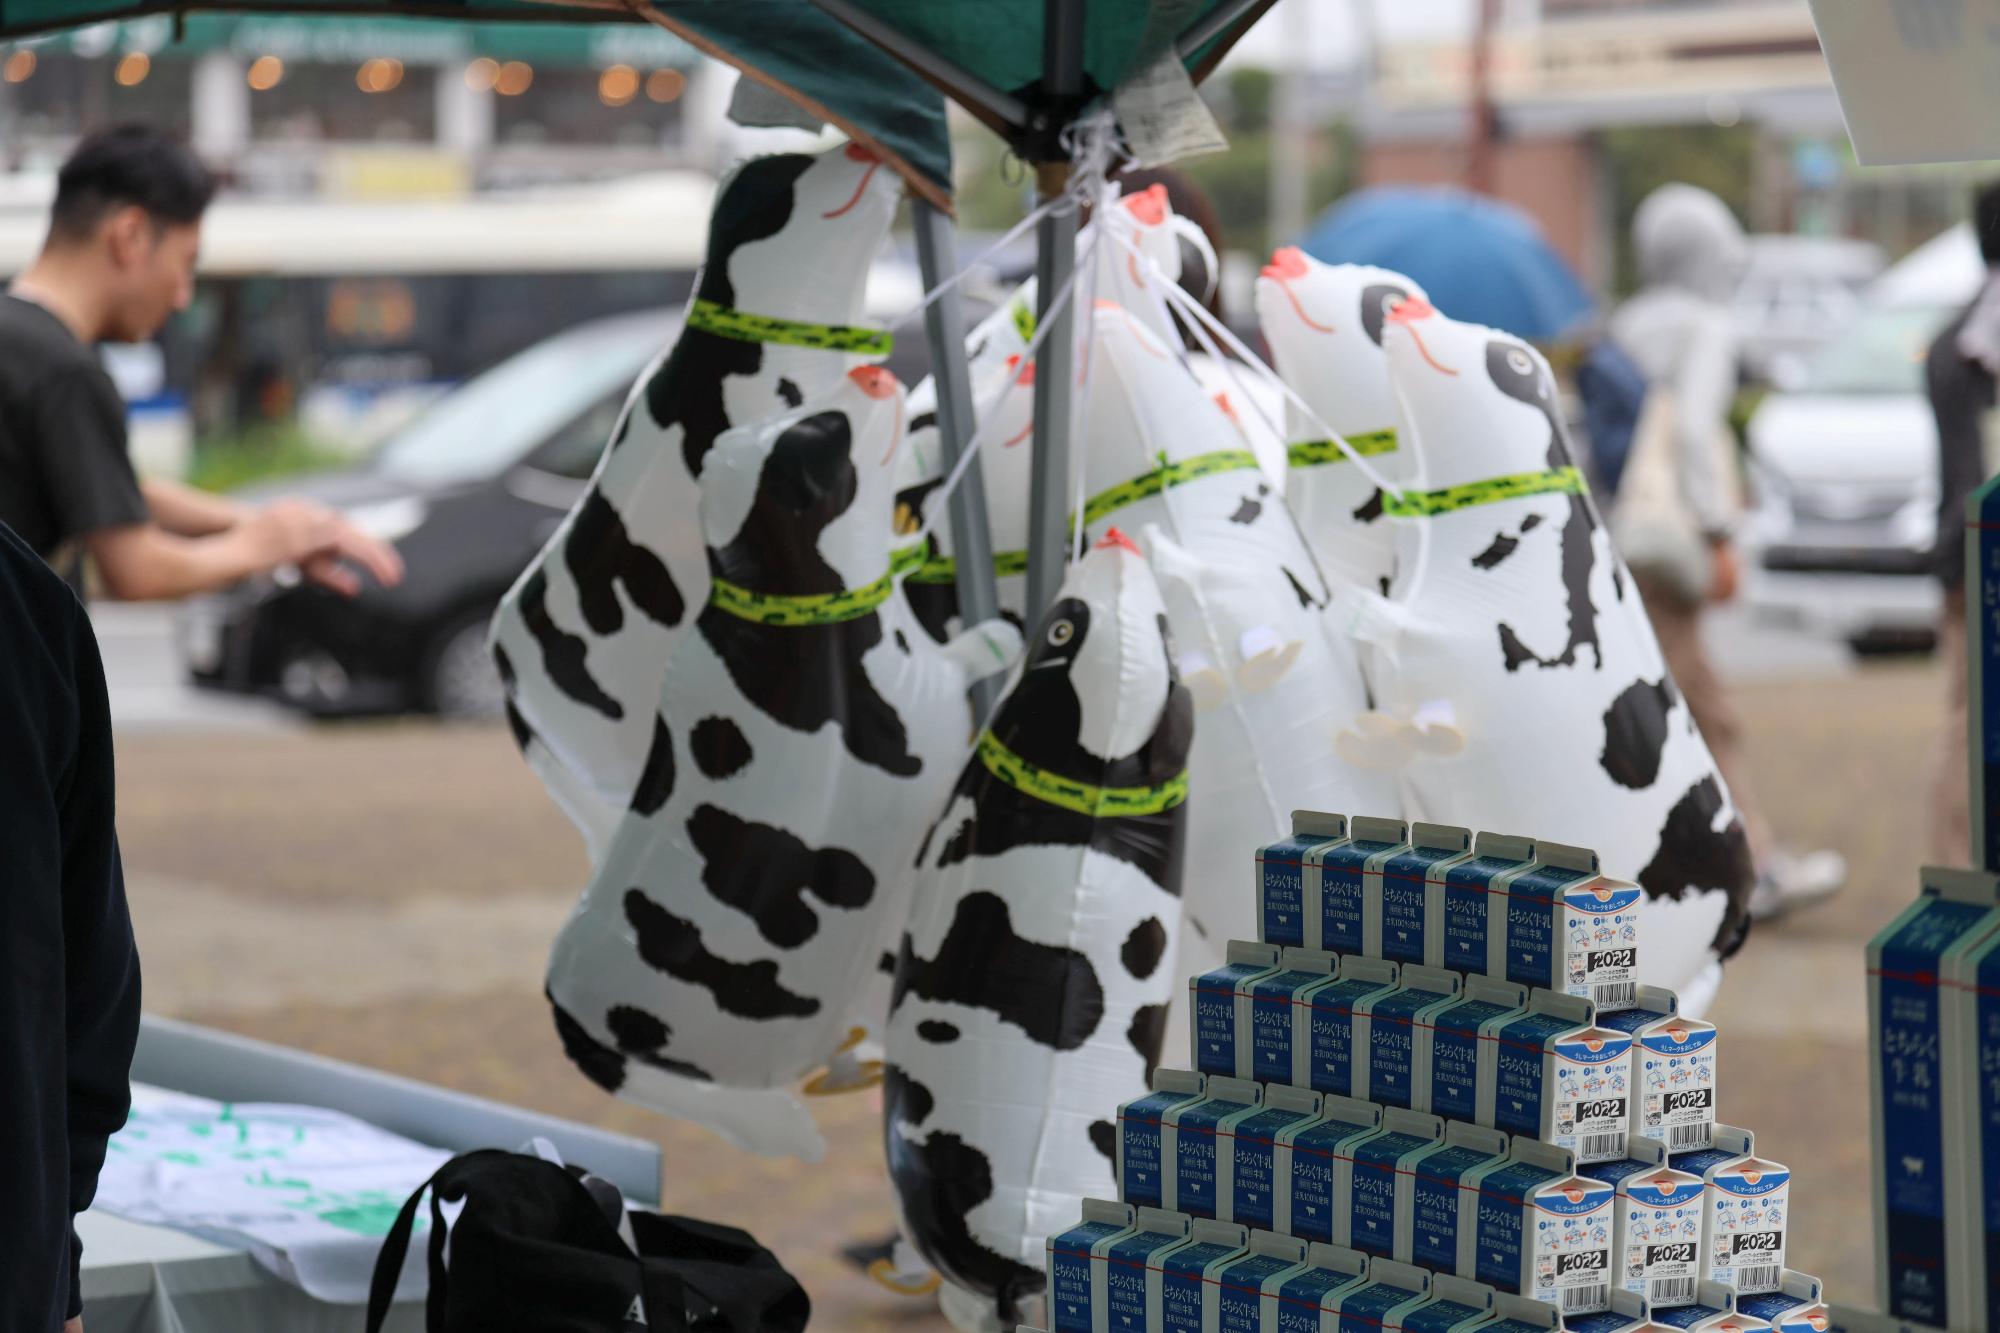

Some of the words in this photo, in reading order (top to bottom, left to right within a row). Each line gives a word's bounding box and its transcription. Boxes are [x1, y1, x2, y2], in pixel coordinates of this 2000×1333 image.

[1265, 873, 1302, 889] とちらく牛乳
[1323, 880, 1361, 897] とちらく牛乳
[1384, 888, 1423, 906] とちらく牛乳
[1446, 898, 1486, 916] とちらく牛乳
[1509, 909, 1551, 928] とちらく牛乳
[1594, 950, 1631, 968] 2022
[1199, 1003, 1233, 1019] とちらく牛乳
[1255, 1010, 1290, 1027] とちらく牛乳
[1313, 1020, 1351, 1038] とちらく牛乳
[1372, 1030, 1411, 1050] とちらく牛乳
[1435, 1042, 1475, 1063] とちらく牛乳
[1500, 1056, 1541, 1077] とちらく牛乳
[1583, 1100, 1620, 1118] 2022
[1670, 1090, 1706, 1109] 2022
[1125, 1131, 1160, 1148] とちらく牛乳
[1178, 1141, 1215, 1159] とちらく牛乳
[1235, 1150, 1272, 1169] とちらく牛乳
[1293, 1162, 1331, 1182] とちらく牛乳
[1353, 1175, 1393, 1197] とちらく牛乳
[1416, 1189, 1456, 1213] とちらく牛乳
[1480, 1206, 1521, 1230] とちらく牛乳
[1739, 1232, 1776, 1251] 2022
[1563, 1252, 1602, 1270] 2022
[1654, 1244, 1690, 1262] 2022
[1055, 1264, 1090, 1281] とちらく牛乳
[1109, 1273, 1144, 1293] とちらく牛乳
[1164, 1285, 1201, 1305] とちらく牛乳
[1221, 1298, 1259, 1320] とちらく牛乳
[1279, 1312, 1318, 1333] とちらく牛乳
